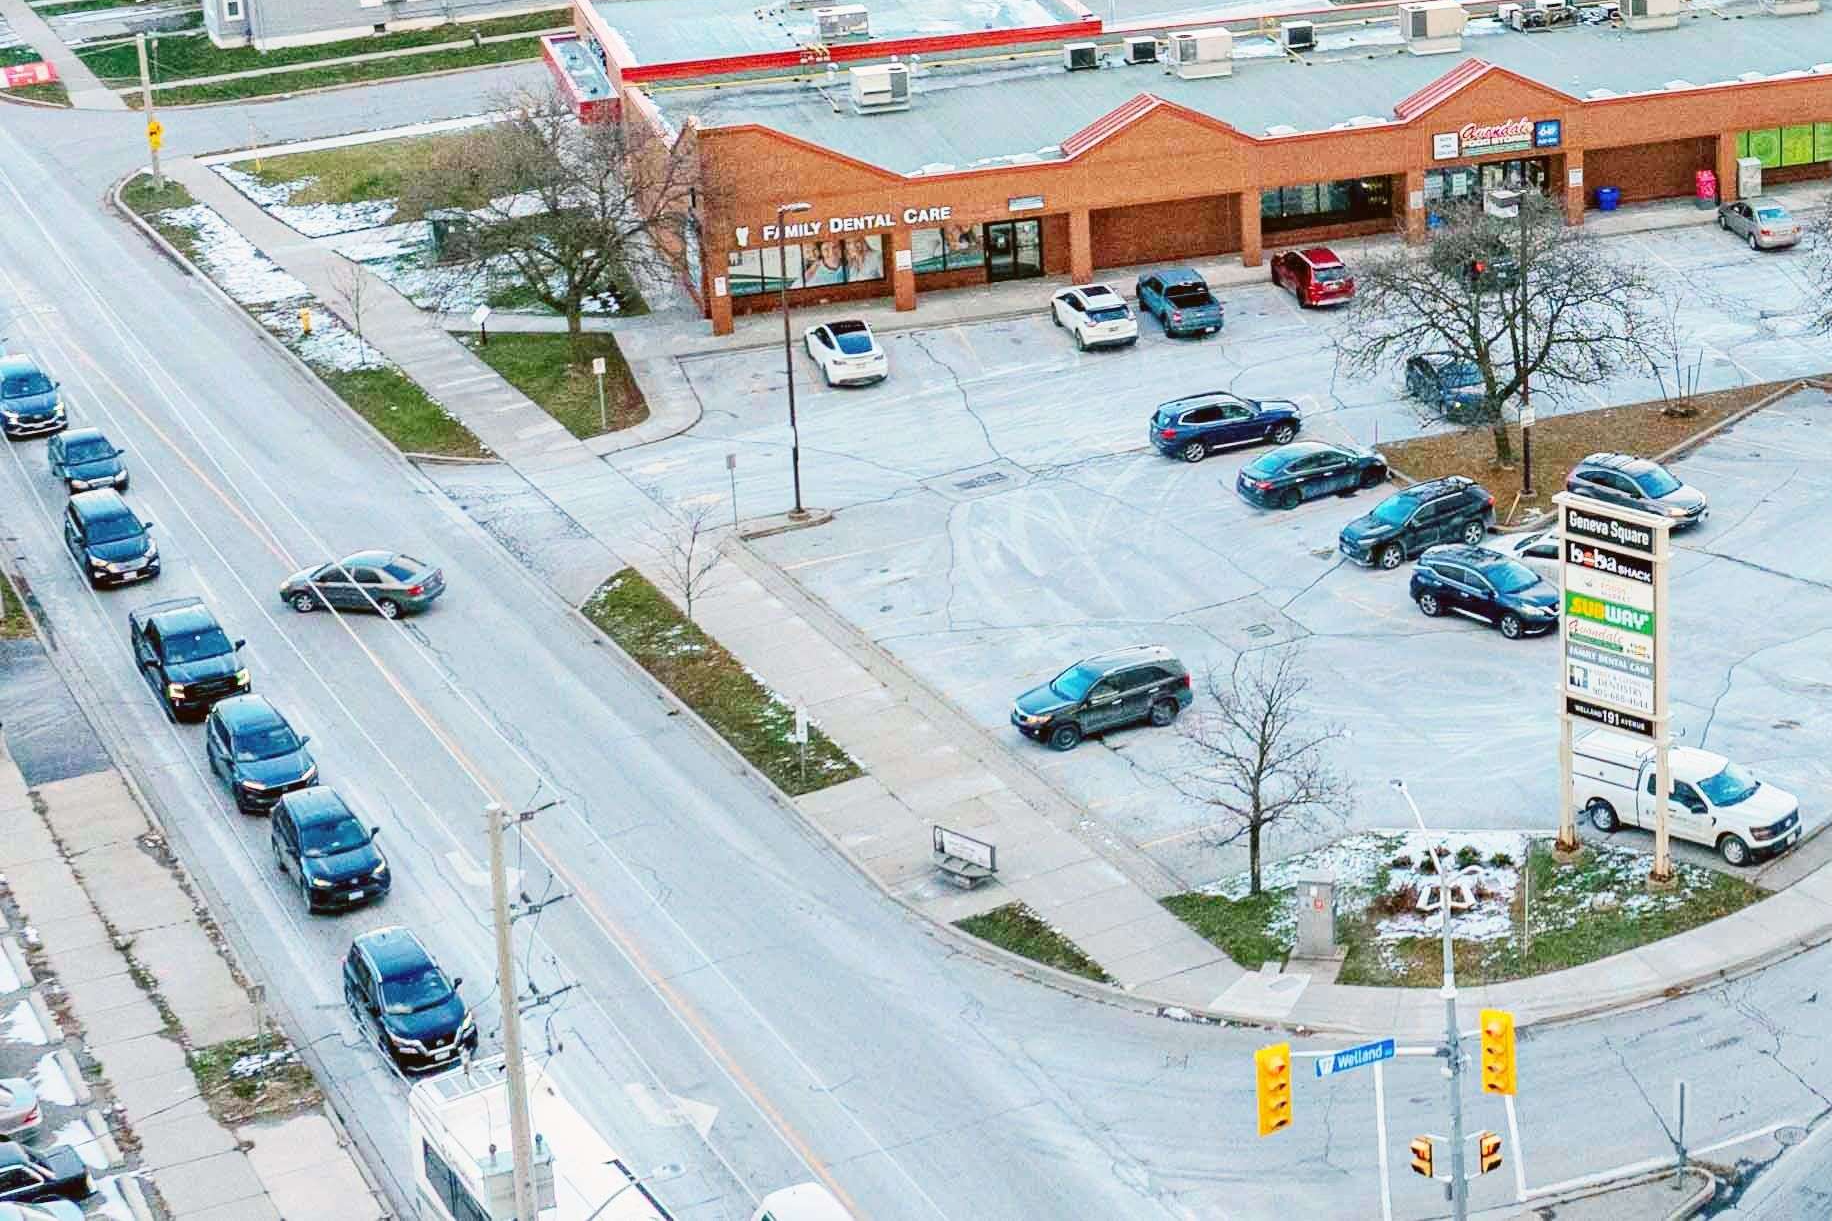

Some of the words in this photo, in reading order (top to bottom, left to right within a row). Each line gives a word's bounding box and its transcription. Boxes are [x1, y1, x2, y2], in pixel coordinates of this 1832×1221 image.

[829, 213, 896, 234] DENTAL
[903, 206, 951, 224] CARE
[1569, 510, 1609, 535] Geneva
[1610, 521, 1649, 546] Square
[1618, 564, 1651, 582] SHACK
[1569, 597, 1650, 631] SUBWAY
[1569, 646, 1596, 661] FAMILY
[1598, 652, 1628, 669] DENTAL
[1629, 660, 1650, 674] CARE
[1574, 704, 1602, 718] WELLAND
[1602, 709, 1620, 726] 191
[1620, 718, 1646, 731] AVENUE
[1337, 1043, 1383, 1069] Welland
